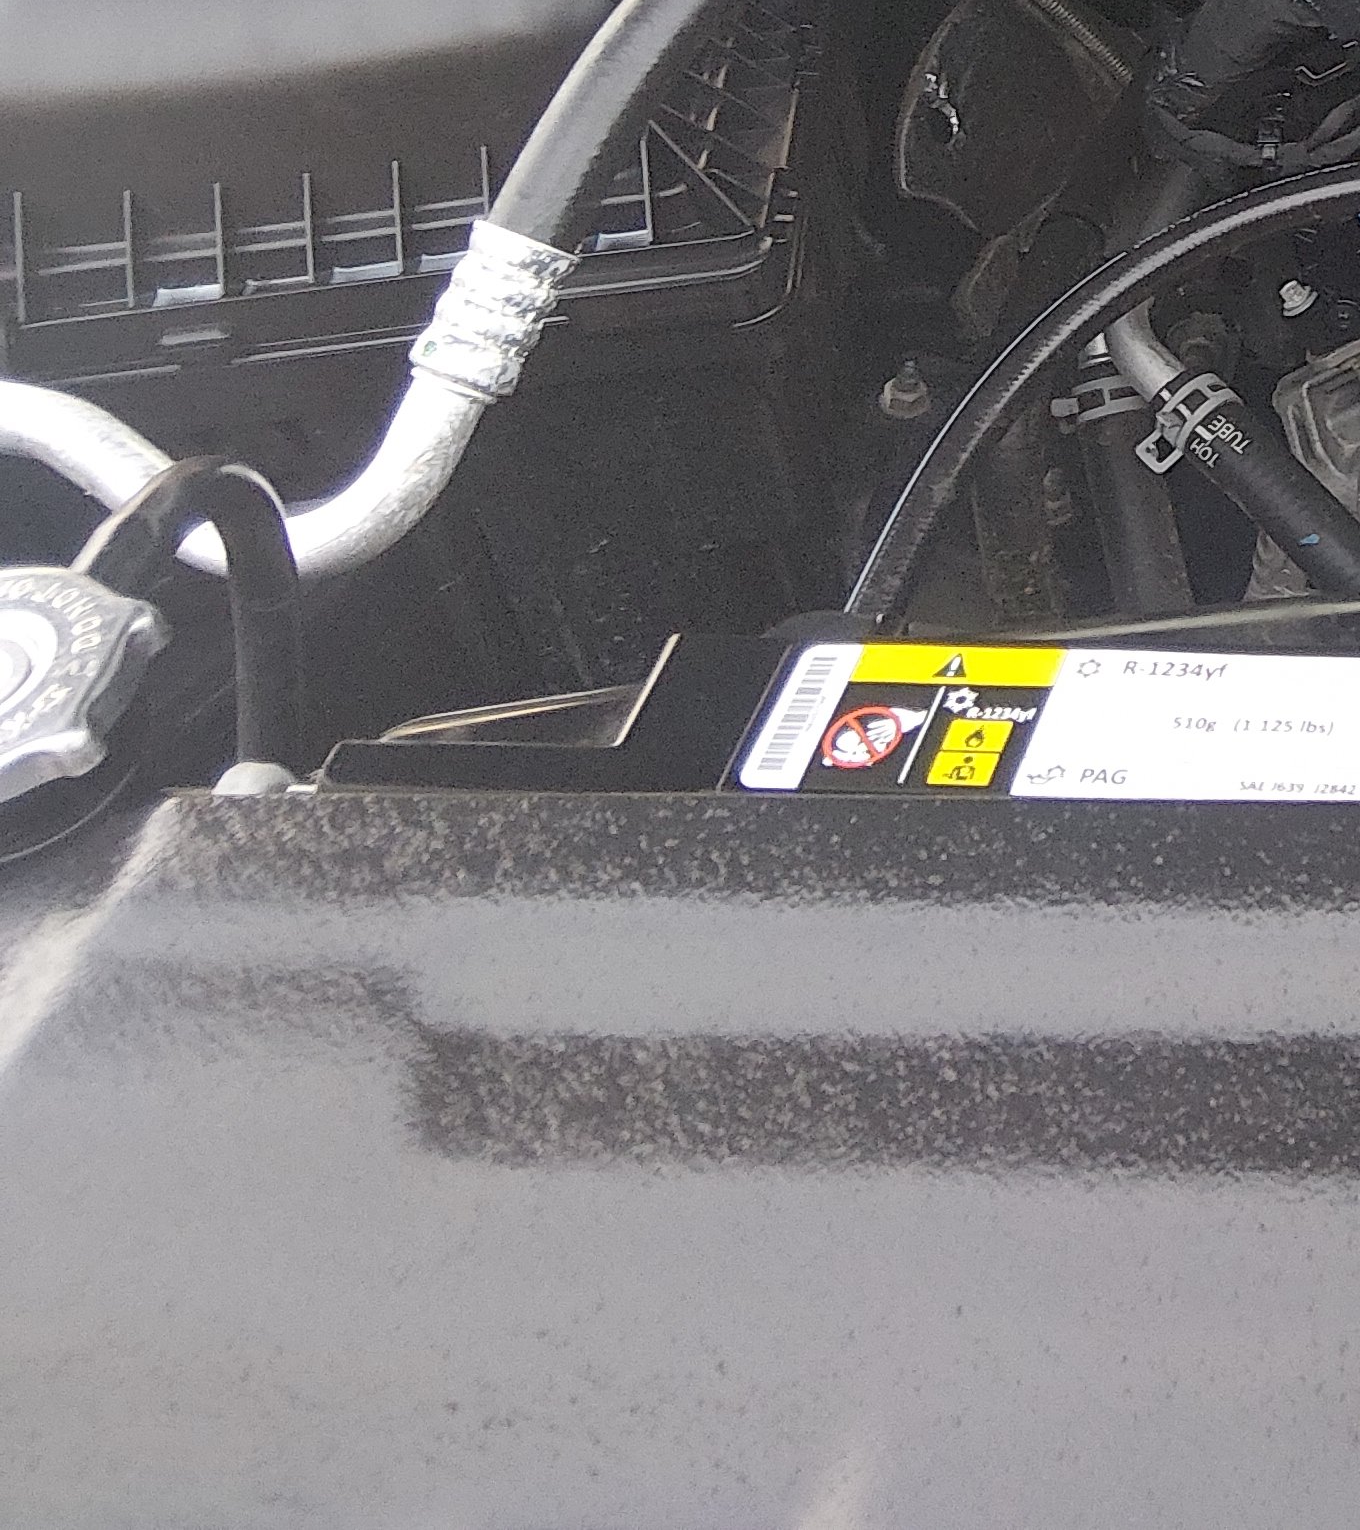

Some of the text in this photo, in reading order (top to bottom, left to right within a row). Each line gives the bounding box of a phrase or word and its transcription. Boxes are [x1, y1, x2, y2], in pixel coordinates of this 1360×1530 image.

[1207, 414, 1252, 455] TUBE
[1189, 437, 1220, 468] TOH
[1122, 660, 1229, 682] R-1234yf
[1079, 768, 1129, 785] PAG
